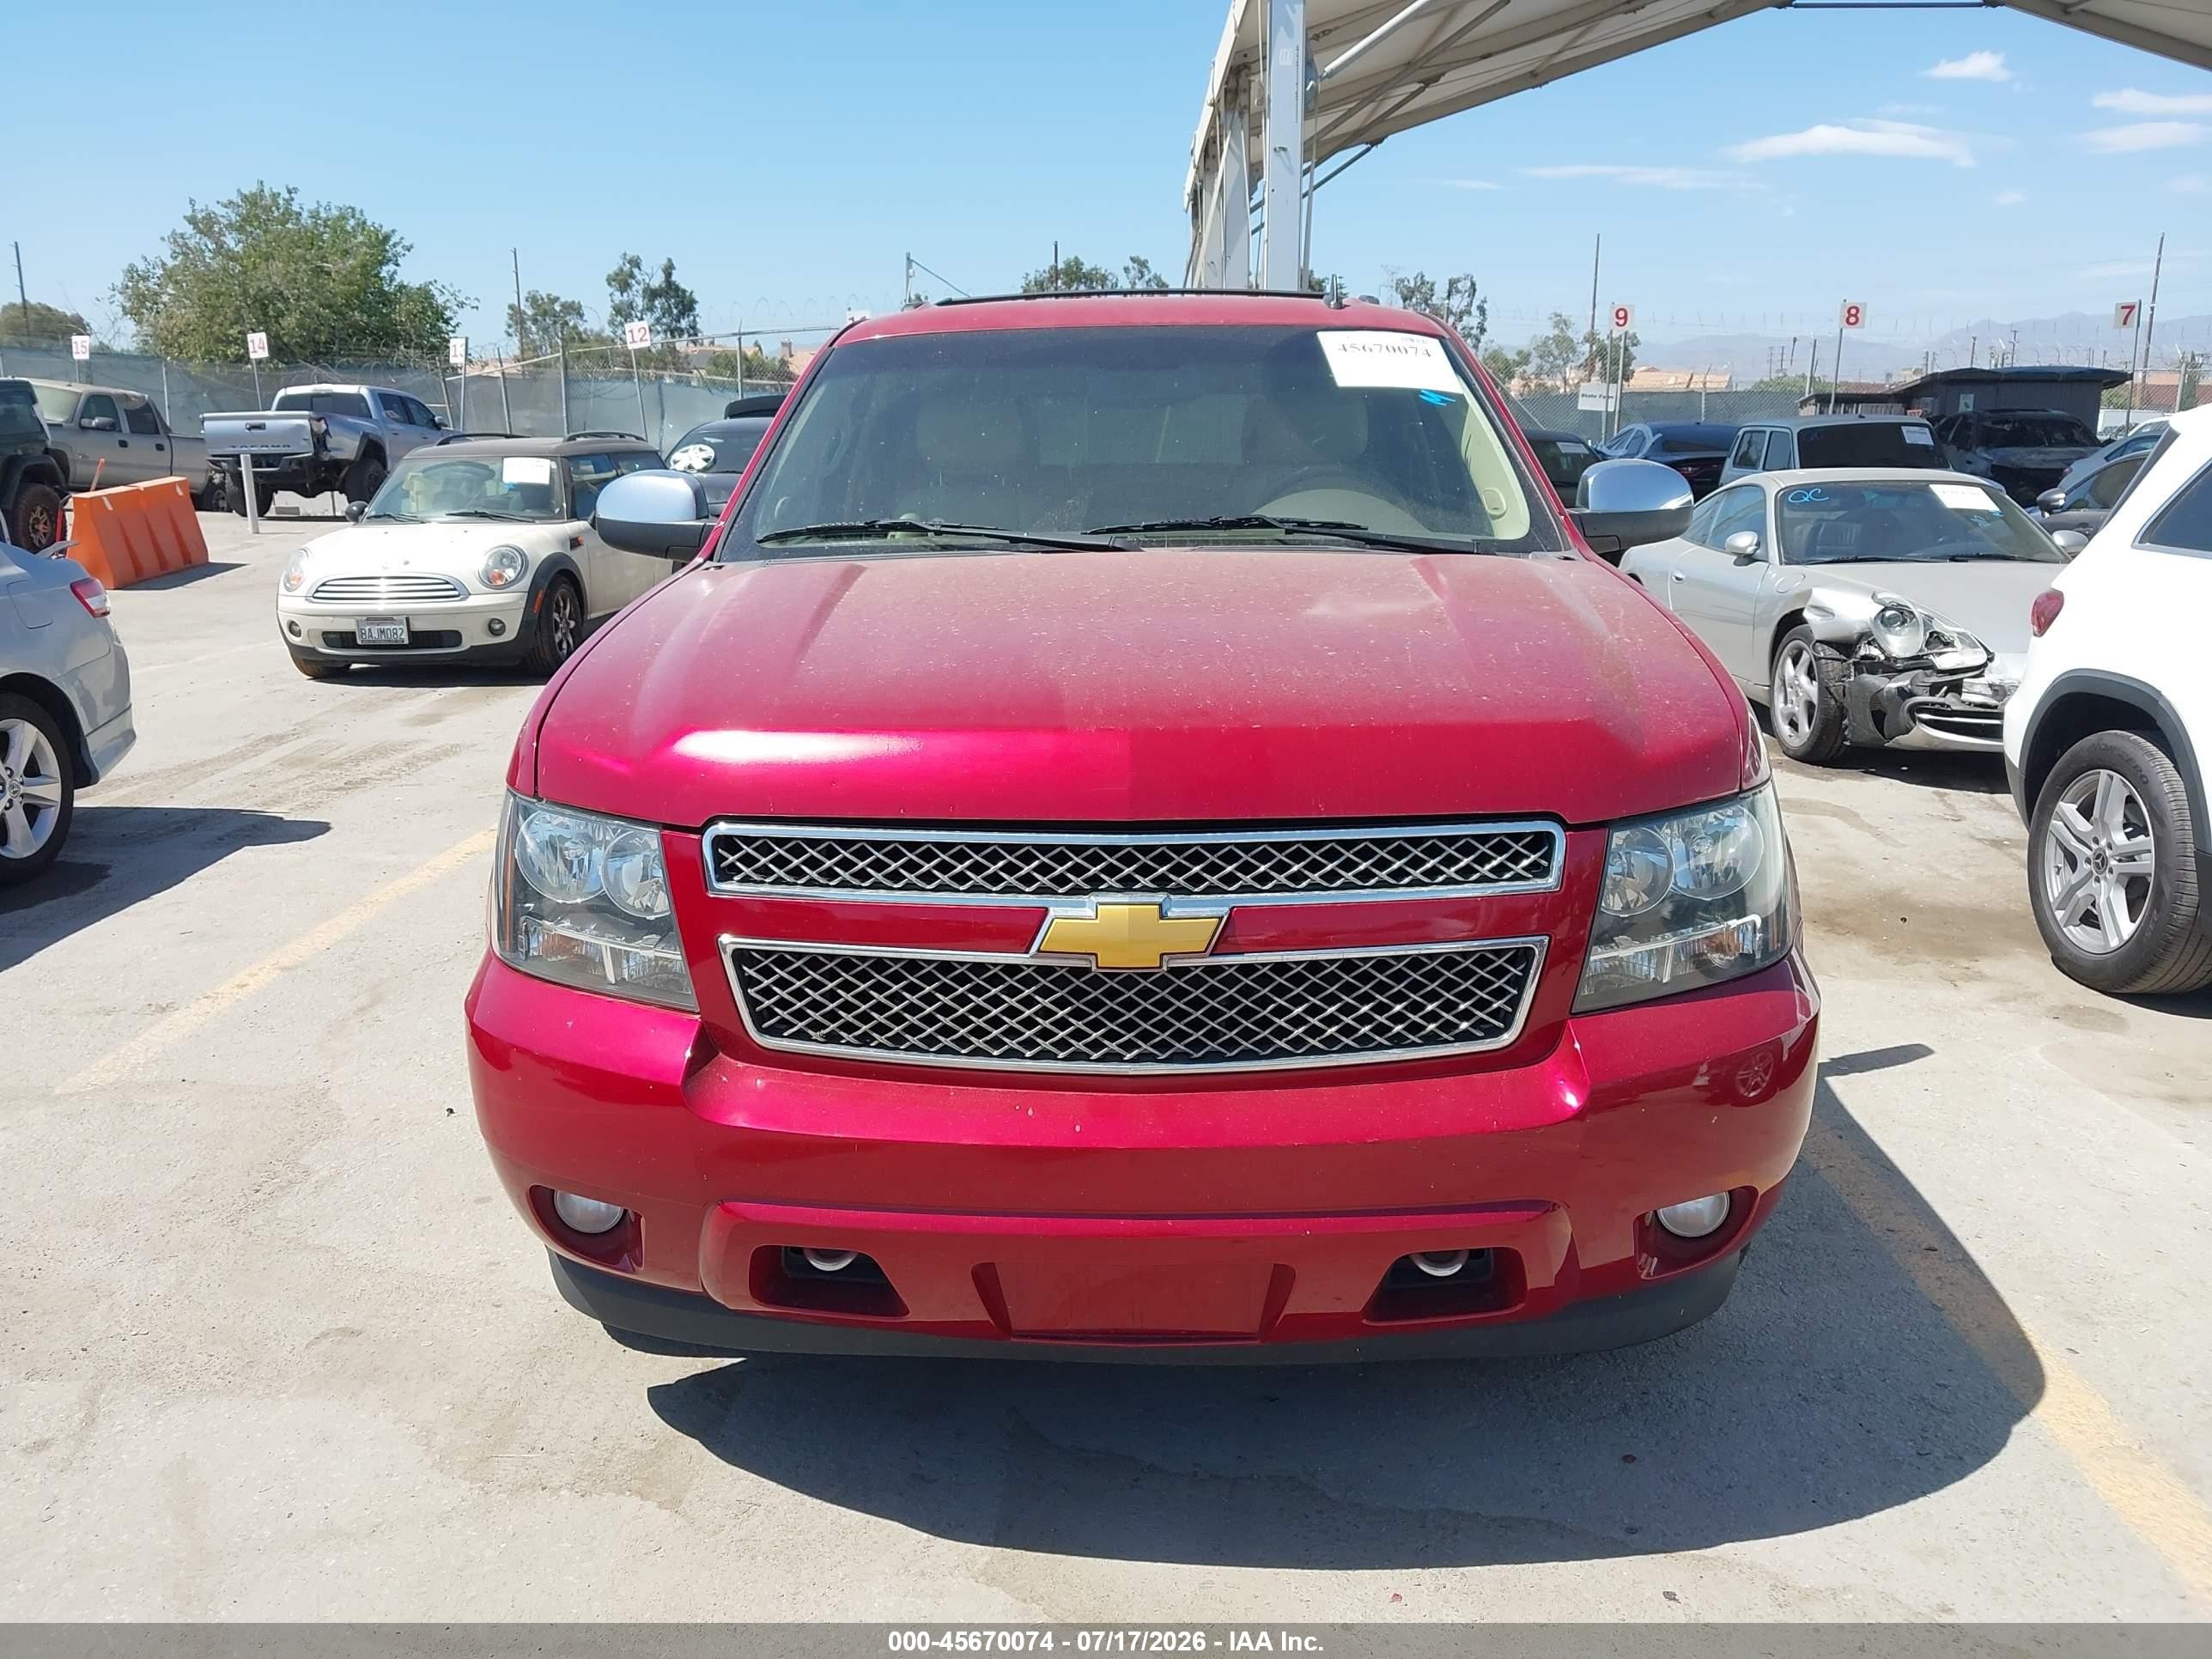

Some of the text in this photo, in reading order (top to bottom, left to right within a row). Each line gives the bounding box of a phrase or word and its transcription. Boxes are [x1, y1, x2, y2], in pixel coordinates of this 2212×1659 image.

[1615, 307, 1628, 327] 9
[1845, 306, 1859, 325] 8
[2121, 305, 2136, 325] 7
[628, 326, 648, 343] 12
[74, 340, 88, 355] 15
[250, 337, 265, 353] 14
[1788, 488, 1829, 503] QC
